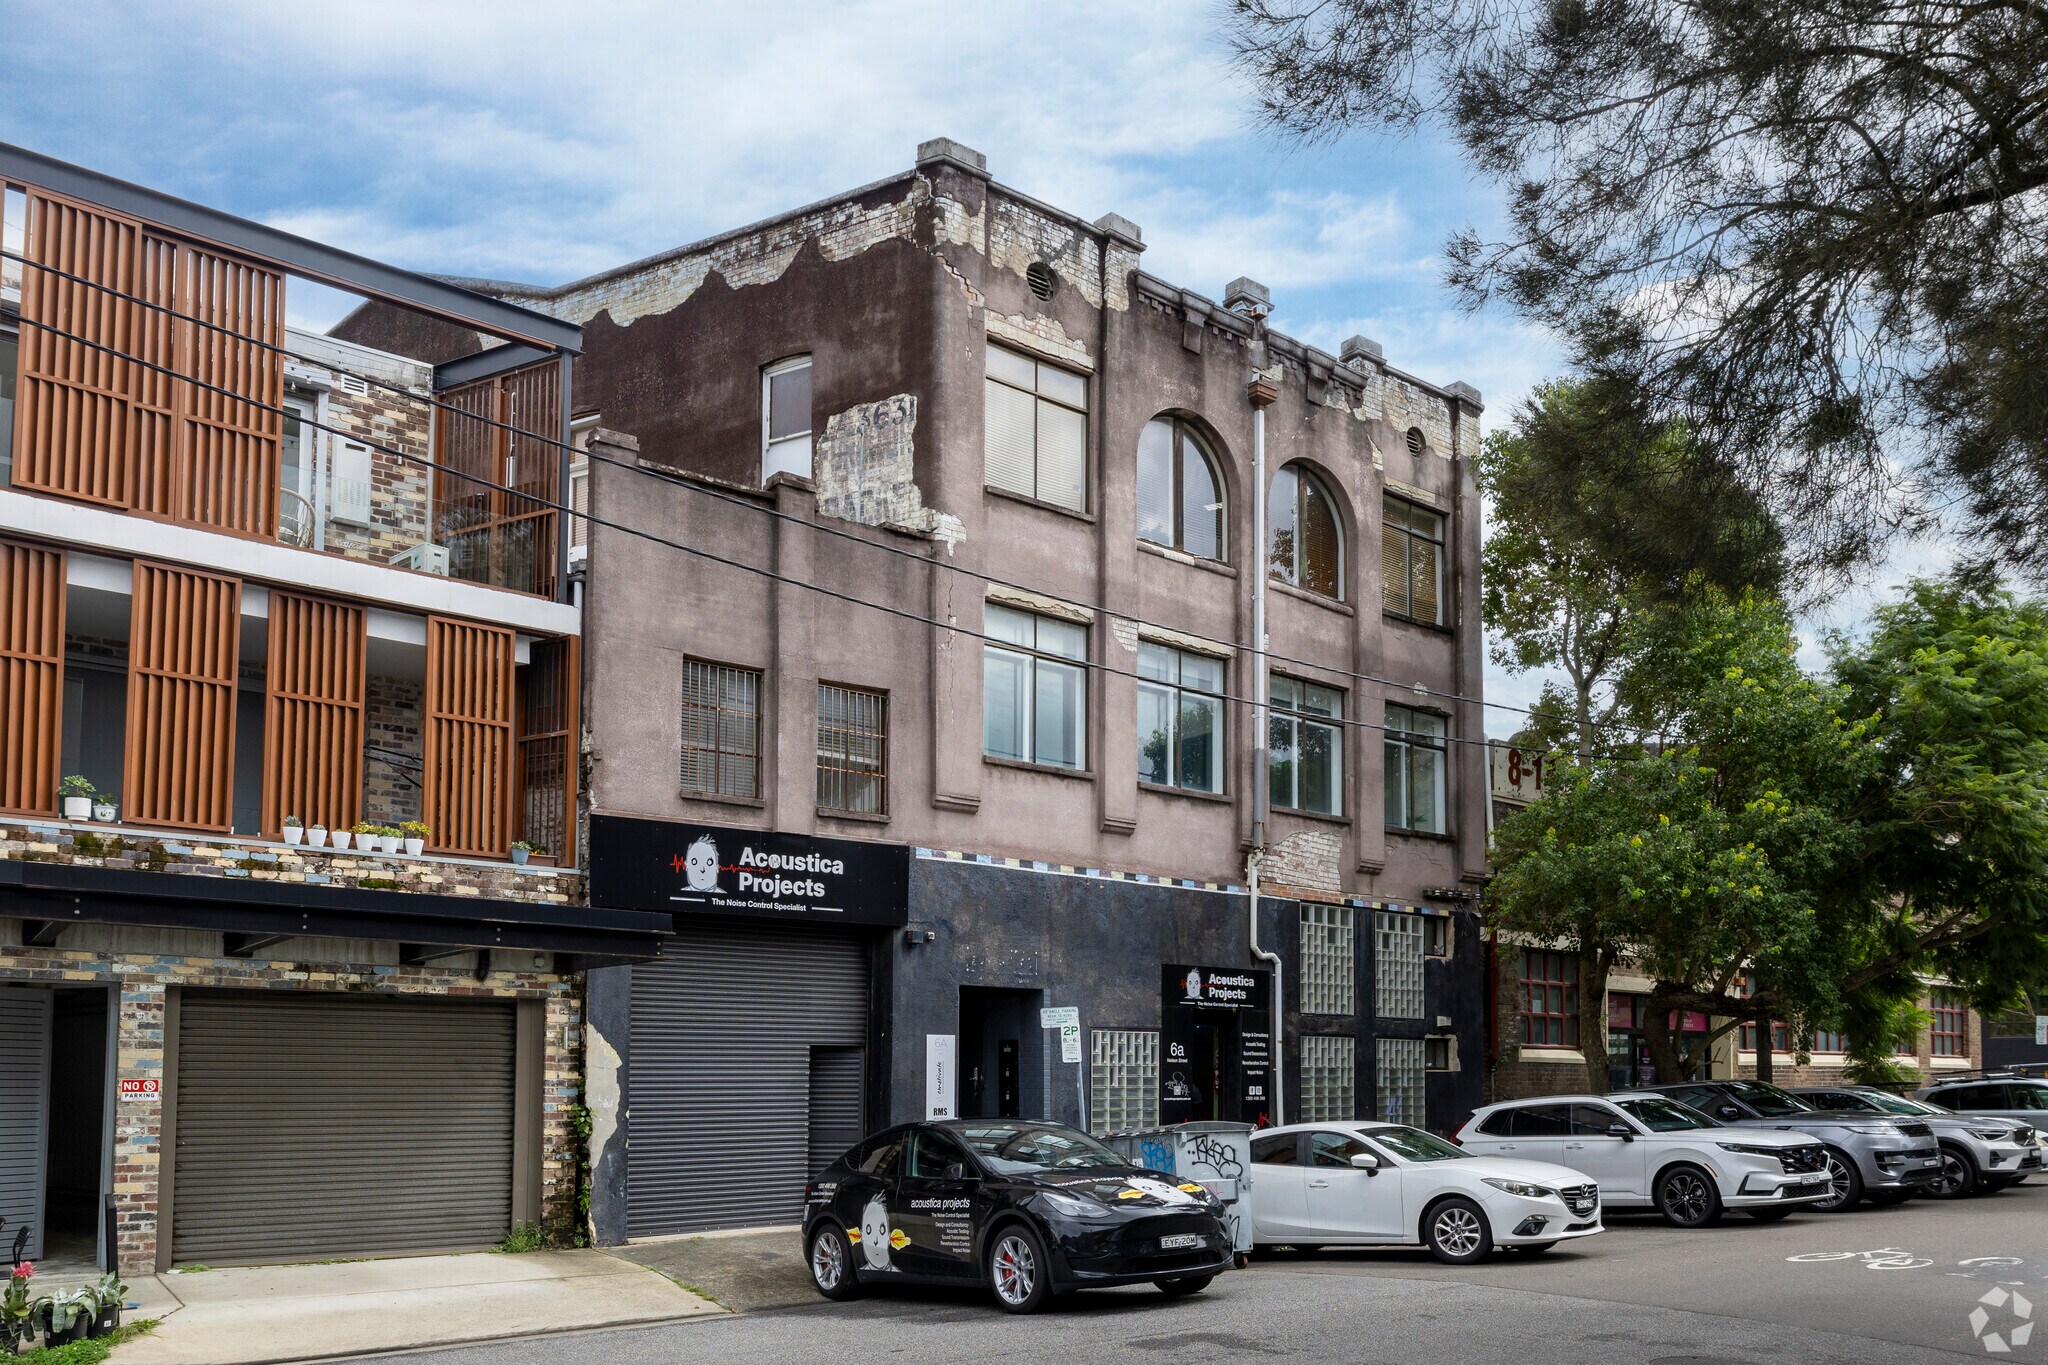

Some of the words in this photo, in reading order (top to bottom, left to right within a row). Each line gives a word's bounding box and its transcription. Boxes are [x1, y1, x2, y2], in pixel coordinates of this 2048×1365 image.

[739, 847, 844, 875] Acoustica
[739, 872, 825, 898] Projects
[711, 898, 725, 906] The
[726, 899, 747, 908] Noise
[747, 900, 773, 909] Control
[774, 902, 807, 912] Specialist
[1208, 973, 1255, 987] Acoustica
[1208, 987, 1247, 1001] Projects
[1063, 1026, 1079, 1036] 2P
[934, 1038, 948, 1048] 6A
[1170, 1042, 1185, 1057] 6a
[123, 1081, 140, 1091] NO
[933, 1107, 948, 1117] RMS
[911, 1197, 941, 1209] acoustica
[942, 1197, 970, 1211] projects
